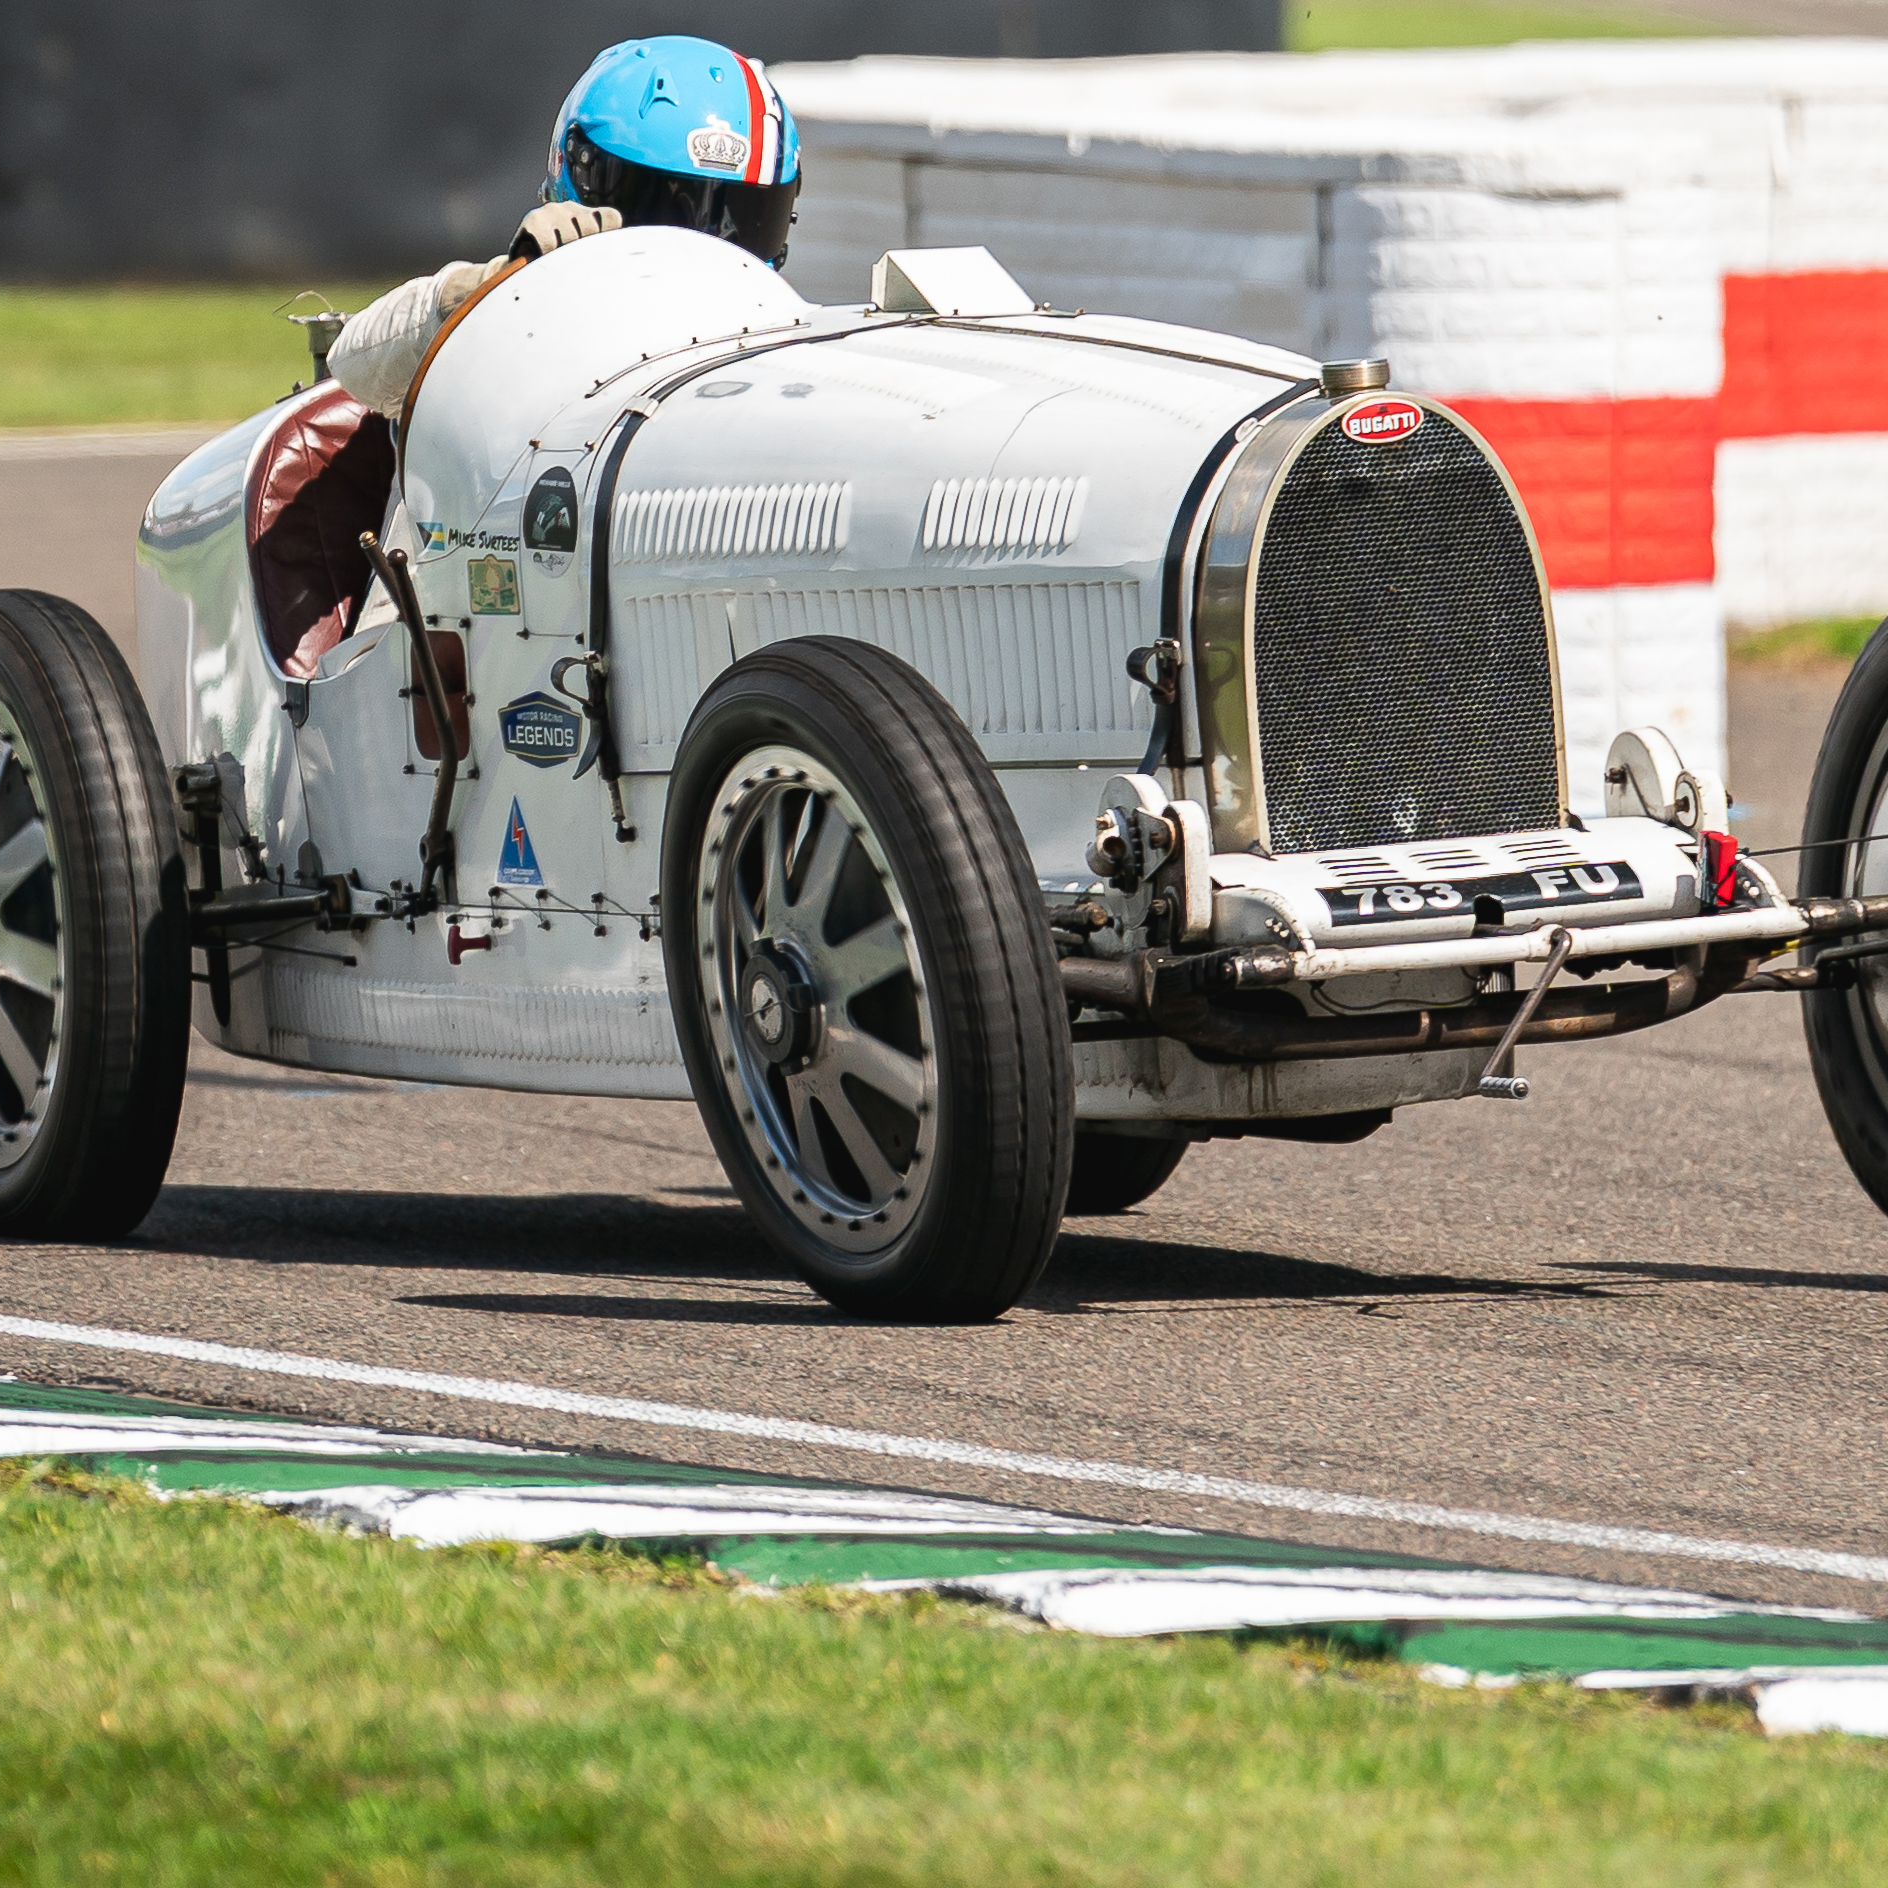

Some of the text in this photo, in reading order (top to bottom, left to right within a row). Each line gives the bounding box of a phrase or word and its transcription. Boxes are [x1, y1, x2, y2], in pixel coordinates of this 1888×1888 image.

[1349, 411, 1415, 435] BUGATTI
[447, 528, 520, 552] MIKE SURTEES
[507, 724, 575, 748] LEGENDS
[1341, 864, 1620, 916] 783 FU
